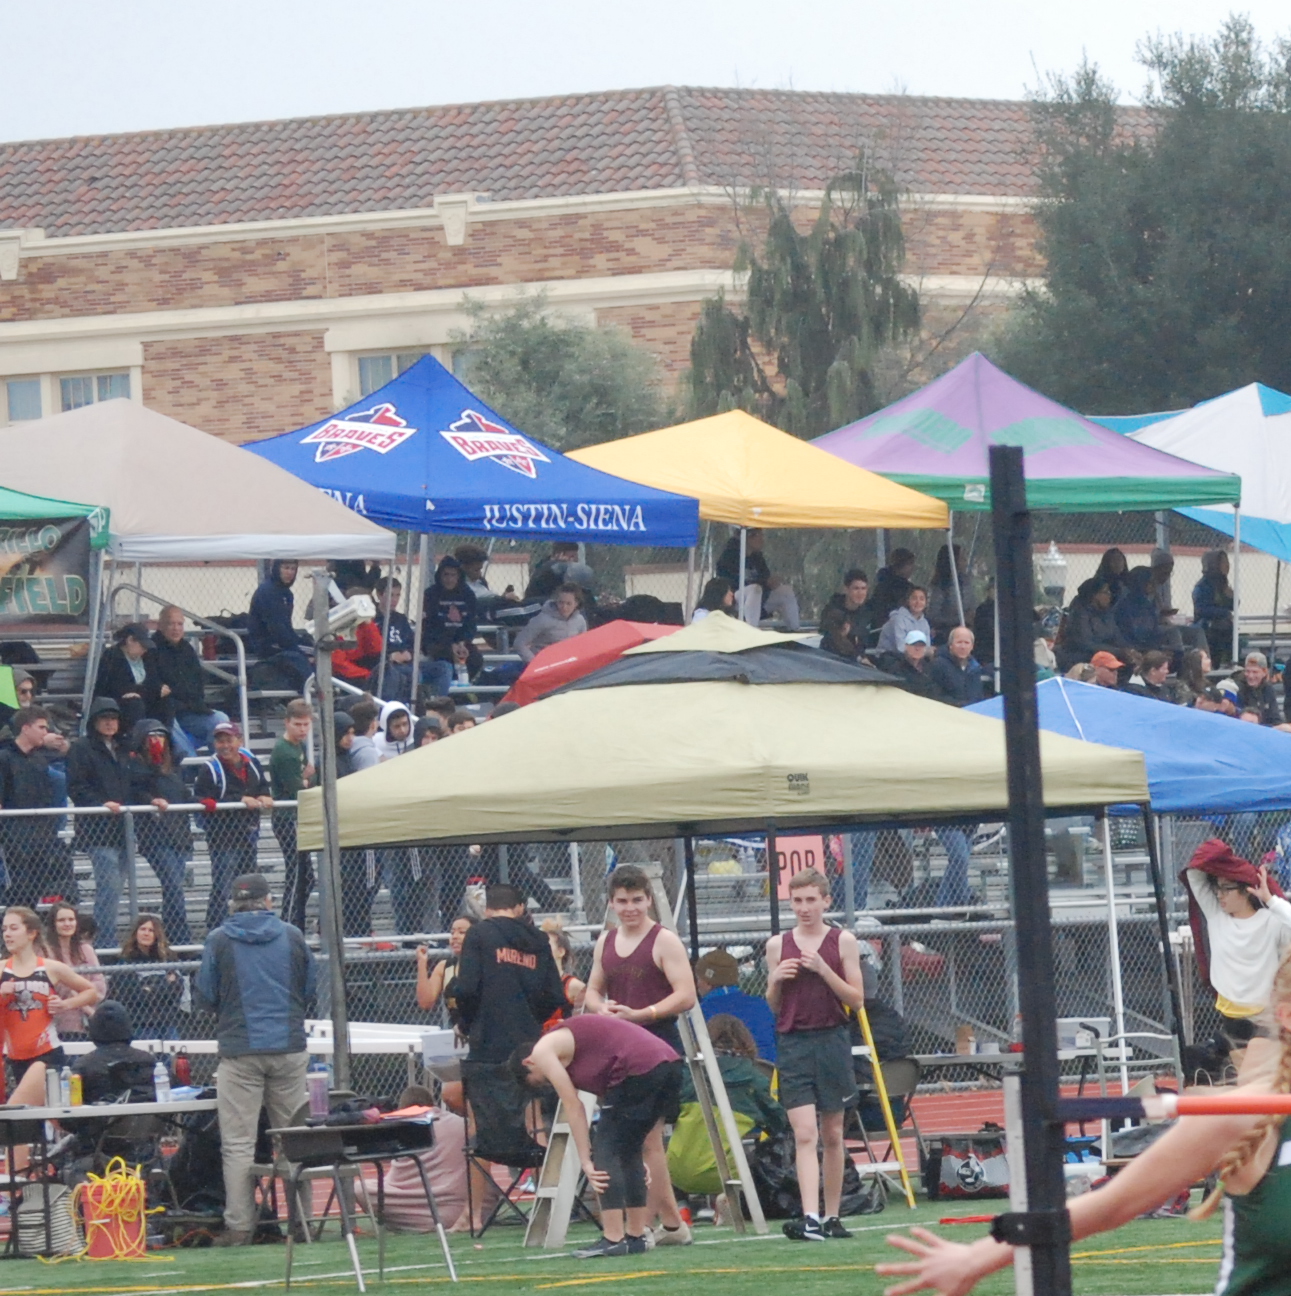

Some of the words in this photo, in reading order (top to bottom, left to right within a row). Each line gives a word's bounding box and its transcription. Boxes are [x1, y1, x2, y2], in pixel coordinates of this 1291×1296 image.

[311, 423, 407, 449] BRAVES
[450, 435, 542, 458] BRAVES
[483, 503, 647, 532] JUSTIN-SIENA
